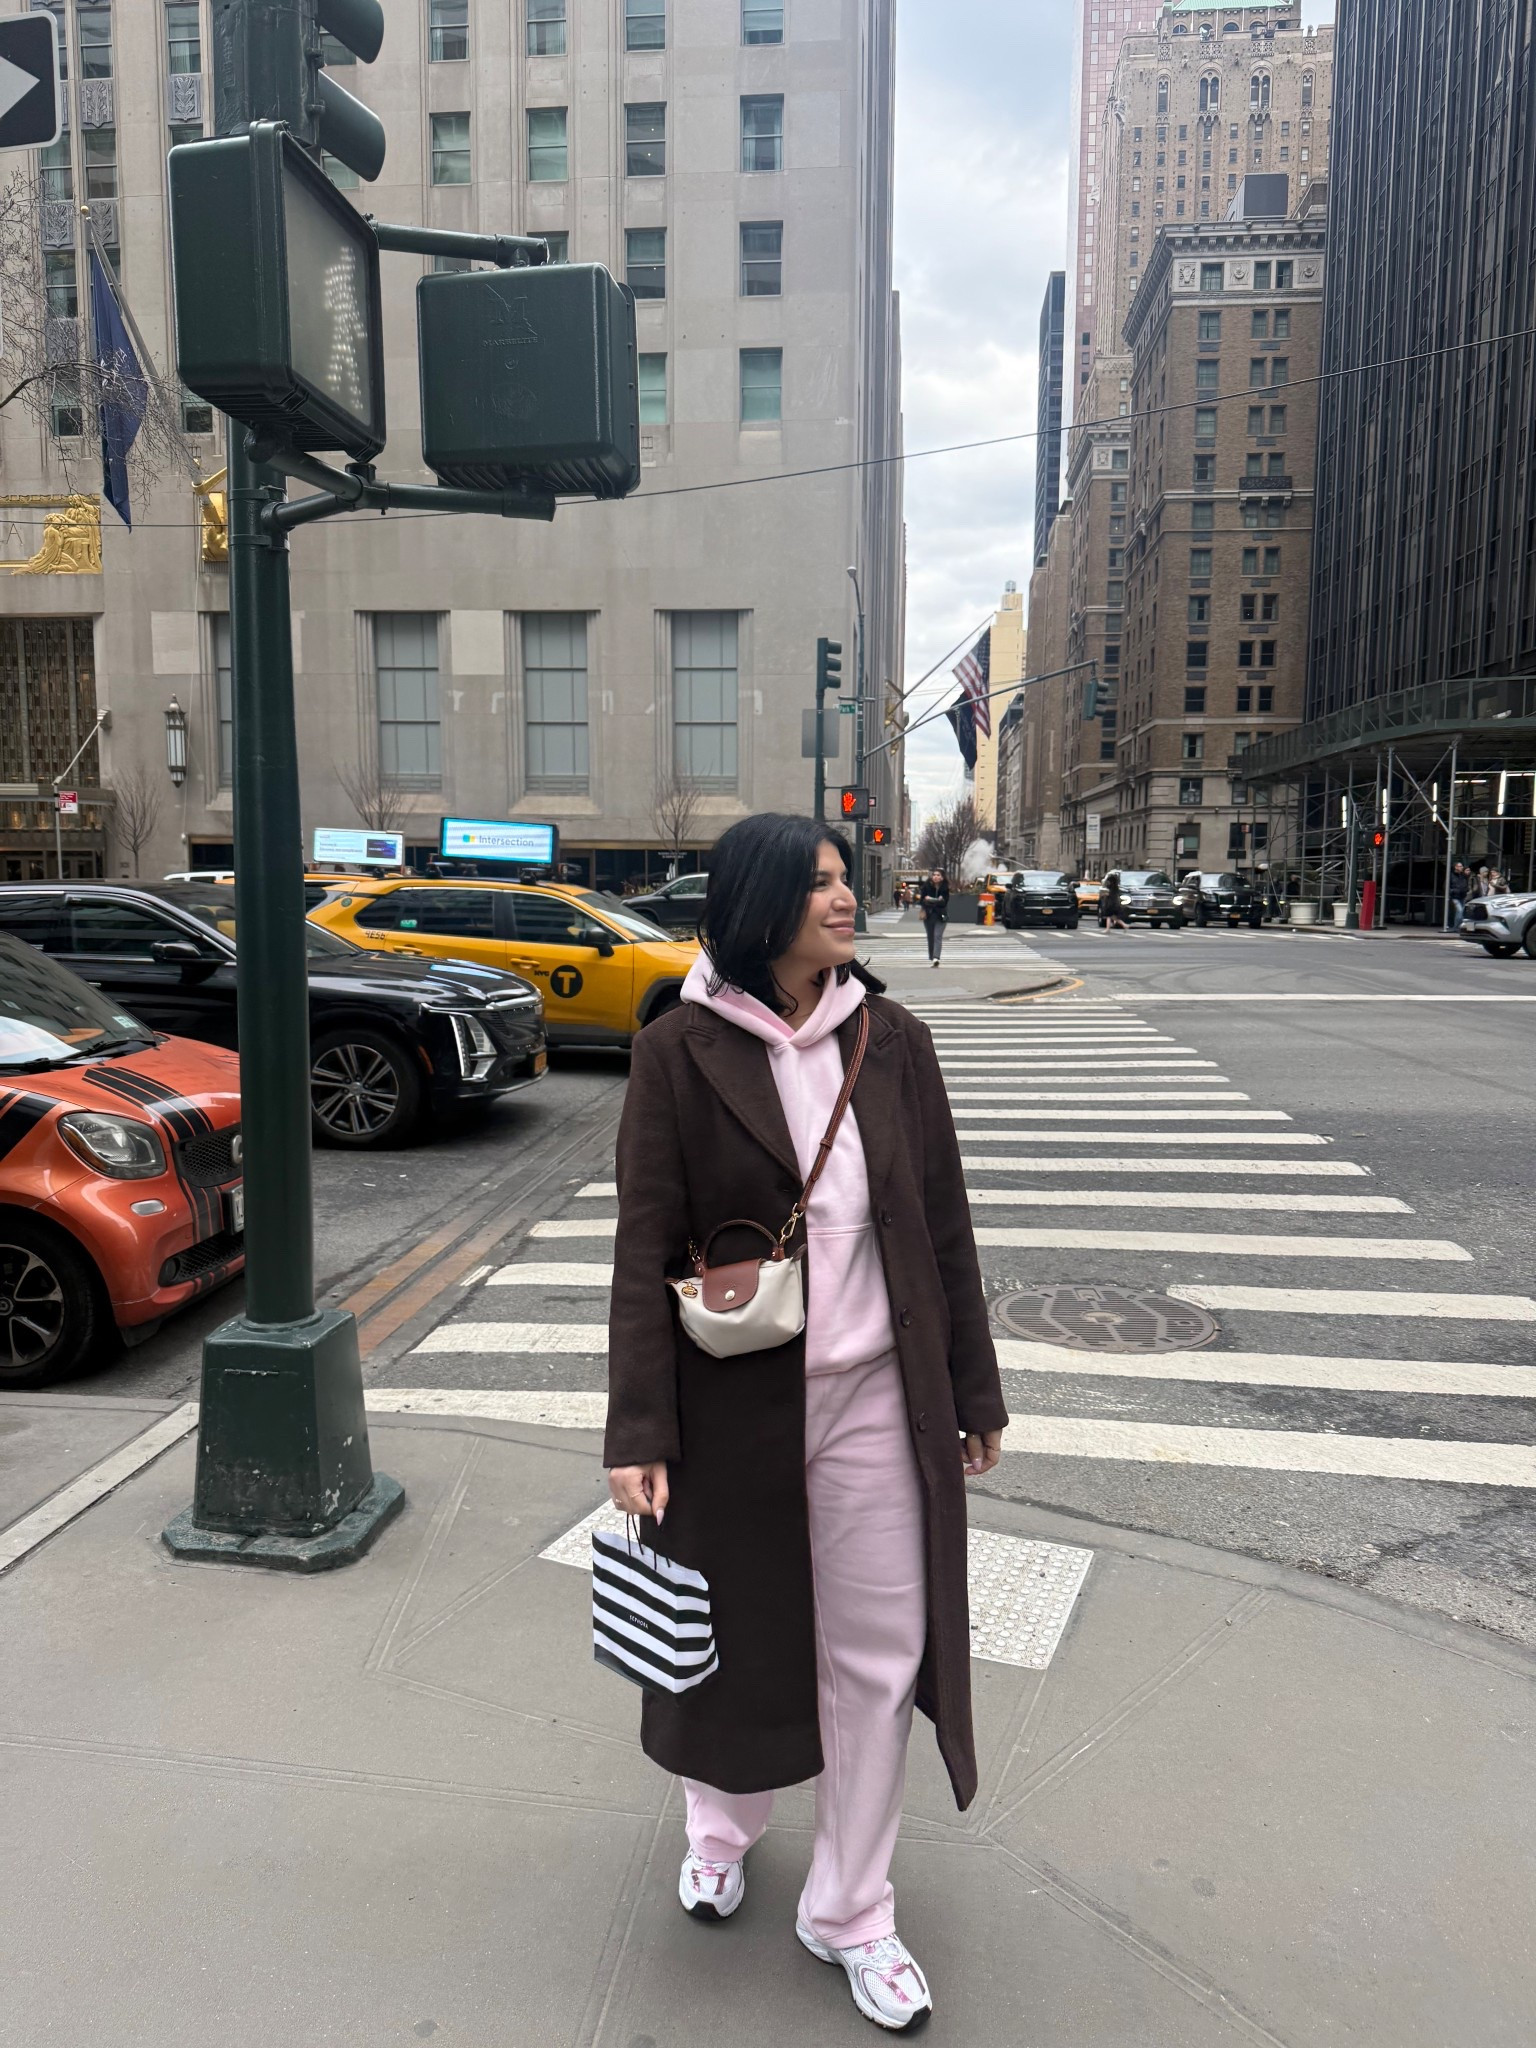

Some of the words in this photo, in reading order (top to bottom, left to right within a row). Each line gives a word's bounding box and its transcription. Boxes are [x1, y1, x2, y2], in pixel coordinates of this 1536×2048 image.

[479, 835, 534, 847] Intersection
[557, 971, 577, 994] T
[629, 1614, 649, 1629] SEPHORA
